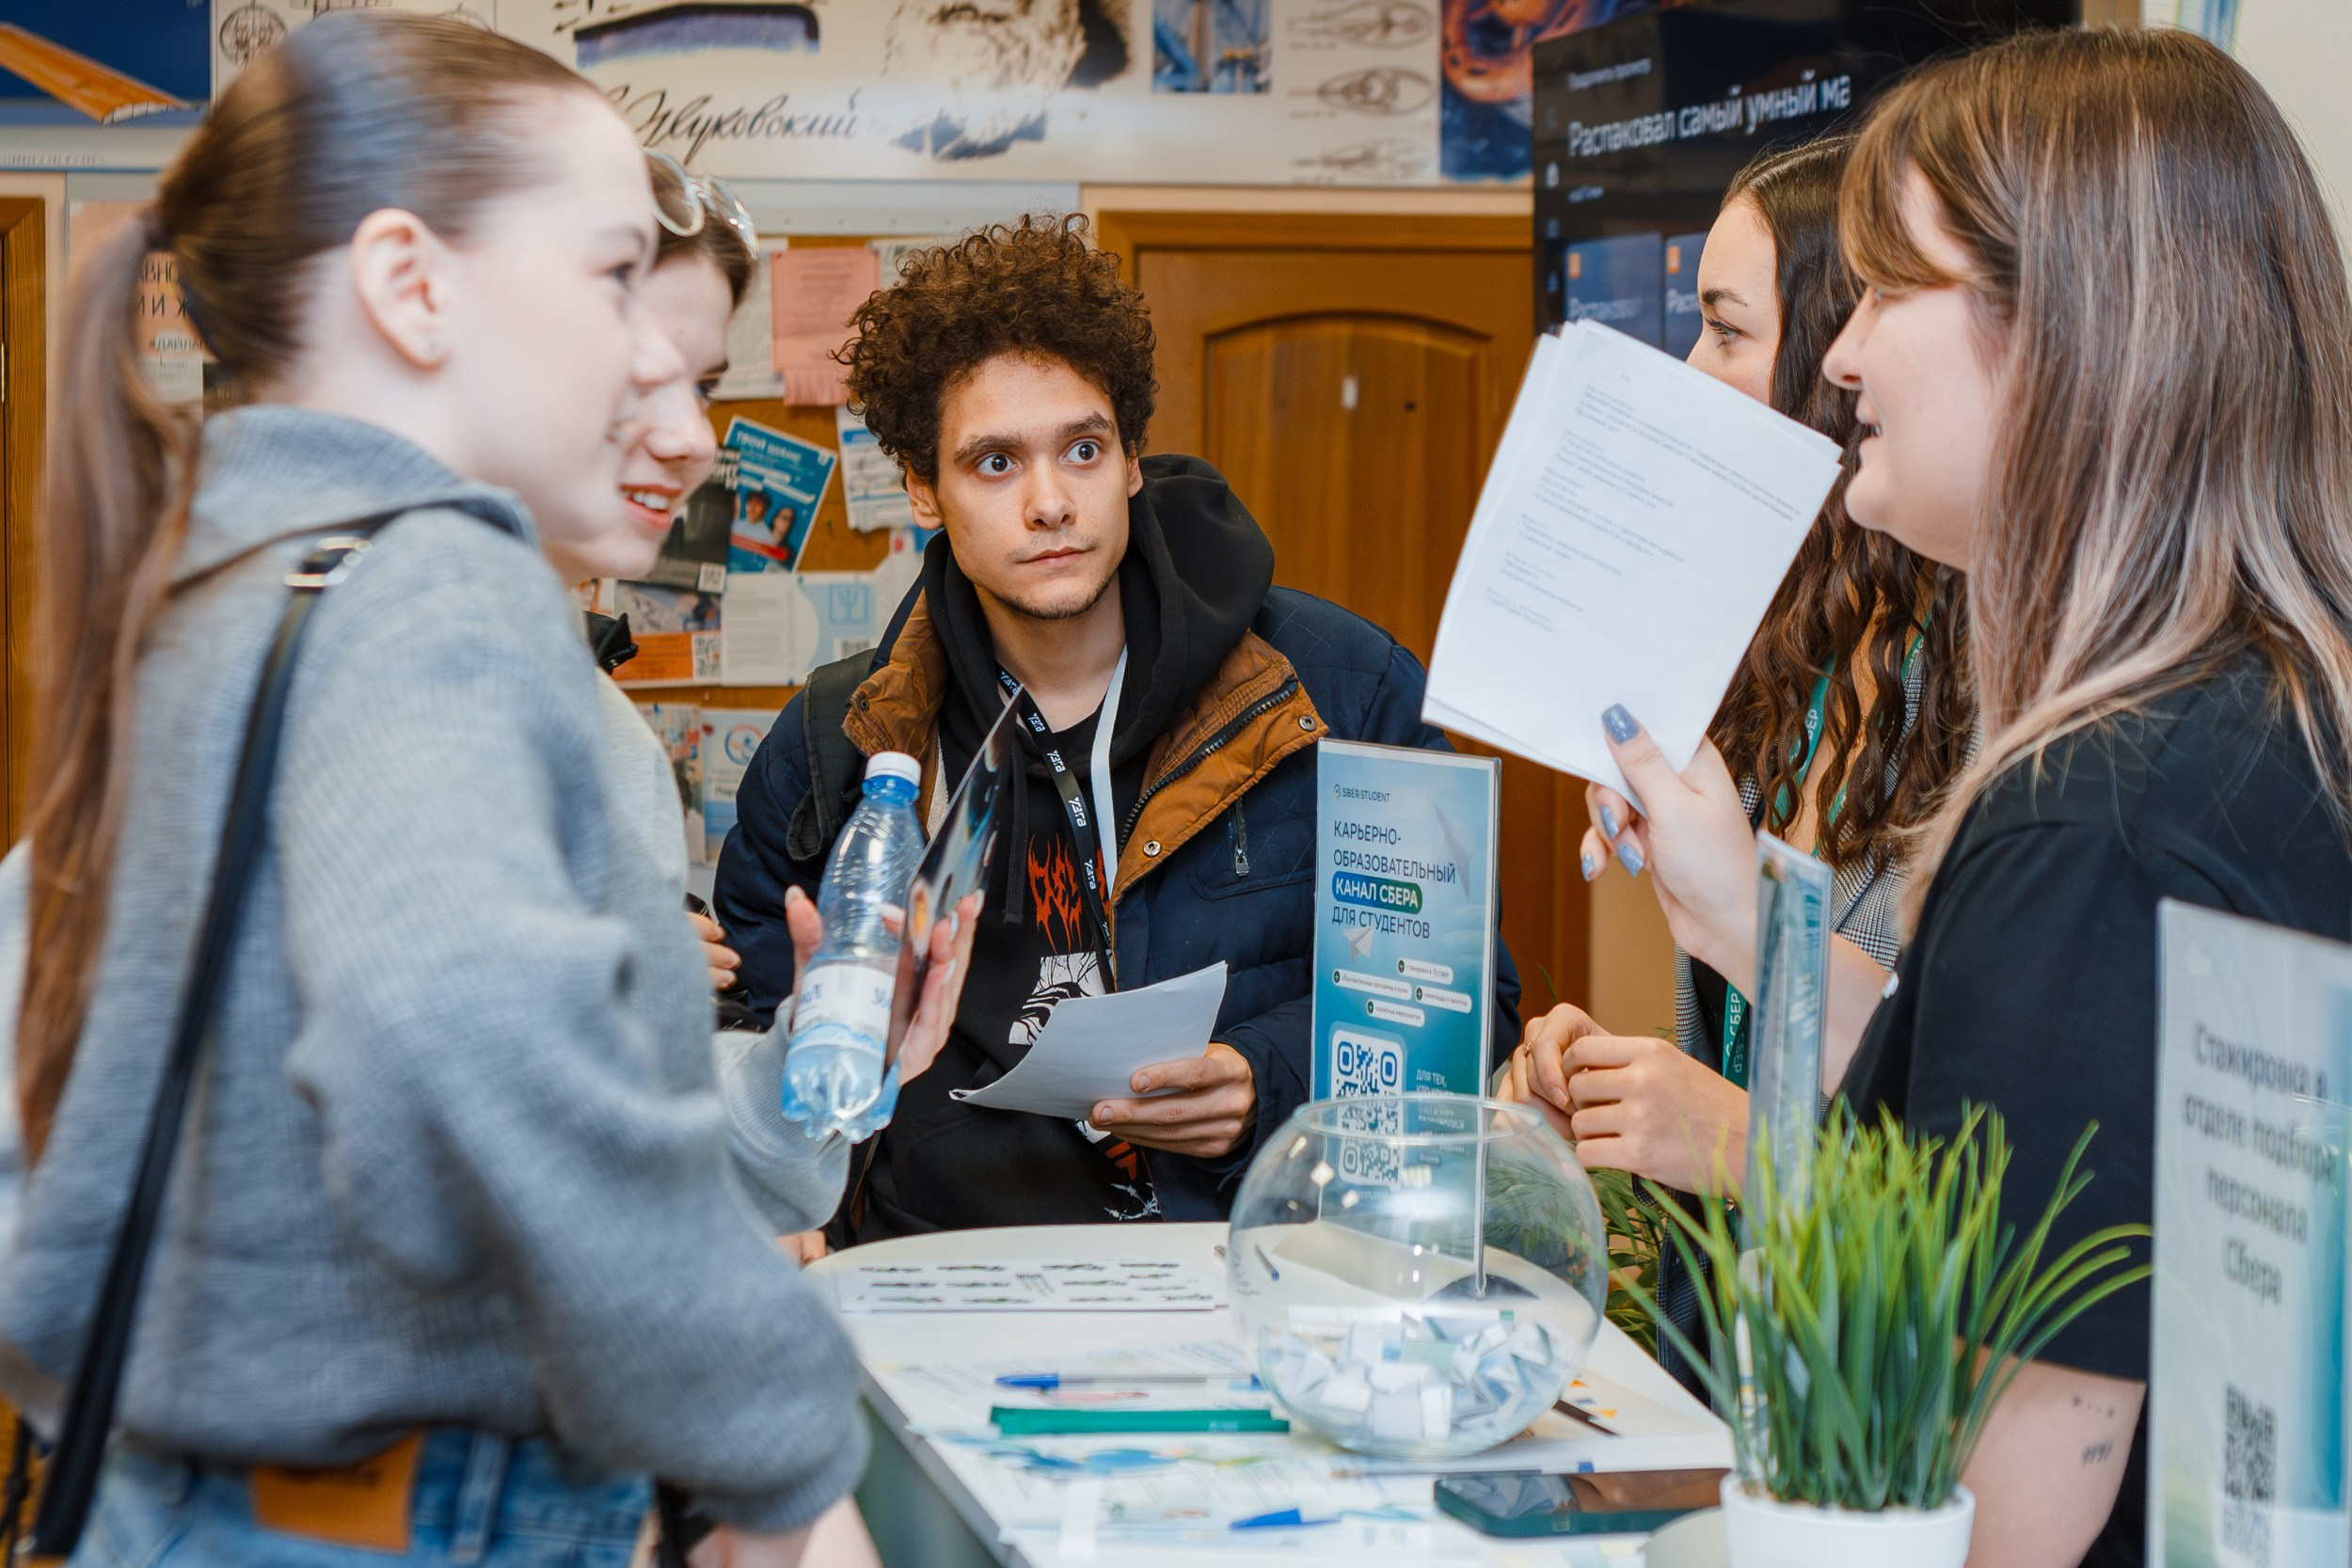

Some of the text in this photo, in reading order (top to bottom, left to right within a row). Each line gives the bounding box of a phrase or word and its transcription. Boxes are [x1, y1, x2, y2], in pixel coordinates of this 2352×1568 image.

[1568, 69, 1851, 158] Распаковал самый умный ма
[1342, 787, 1391, 802] SBER STUDENT
[1333, 820, 1402, 846] КАРЬЕРНО-
[1333, 848, 1456, 884] ОБРАЗОВАТЕЛЬНЫЙ
[1336, 878, 1419, 909] КАНАЛ СБЕРА
[1332, 906, 1431, 939] ДЛЯ СТУДЕНТОВ
[2193, 1019, 2309, 1094] Стажировка
[1416, 1069, 1447, 1087] ДЛЯ ТЕХ,
[2184, 1092, 2337, 1183] отделе подбора
[2206, 1164, 2309, 1243] персонала
[2224, 1236, 2282, 1306] Сбера
